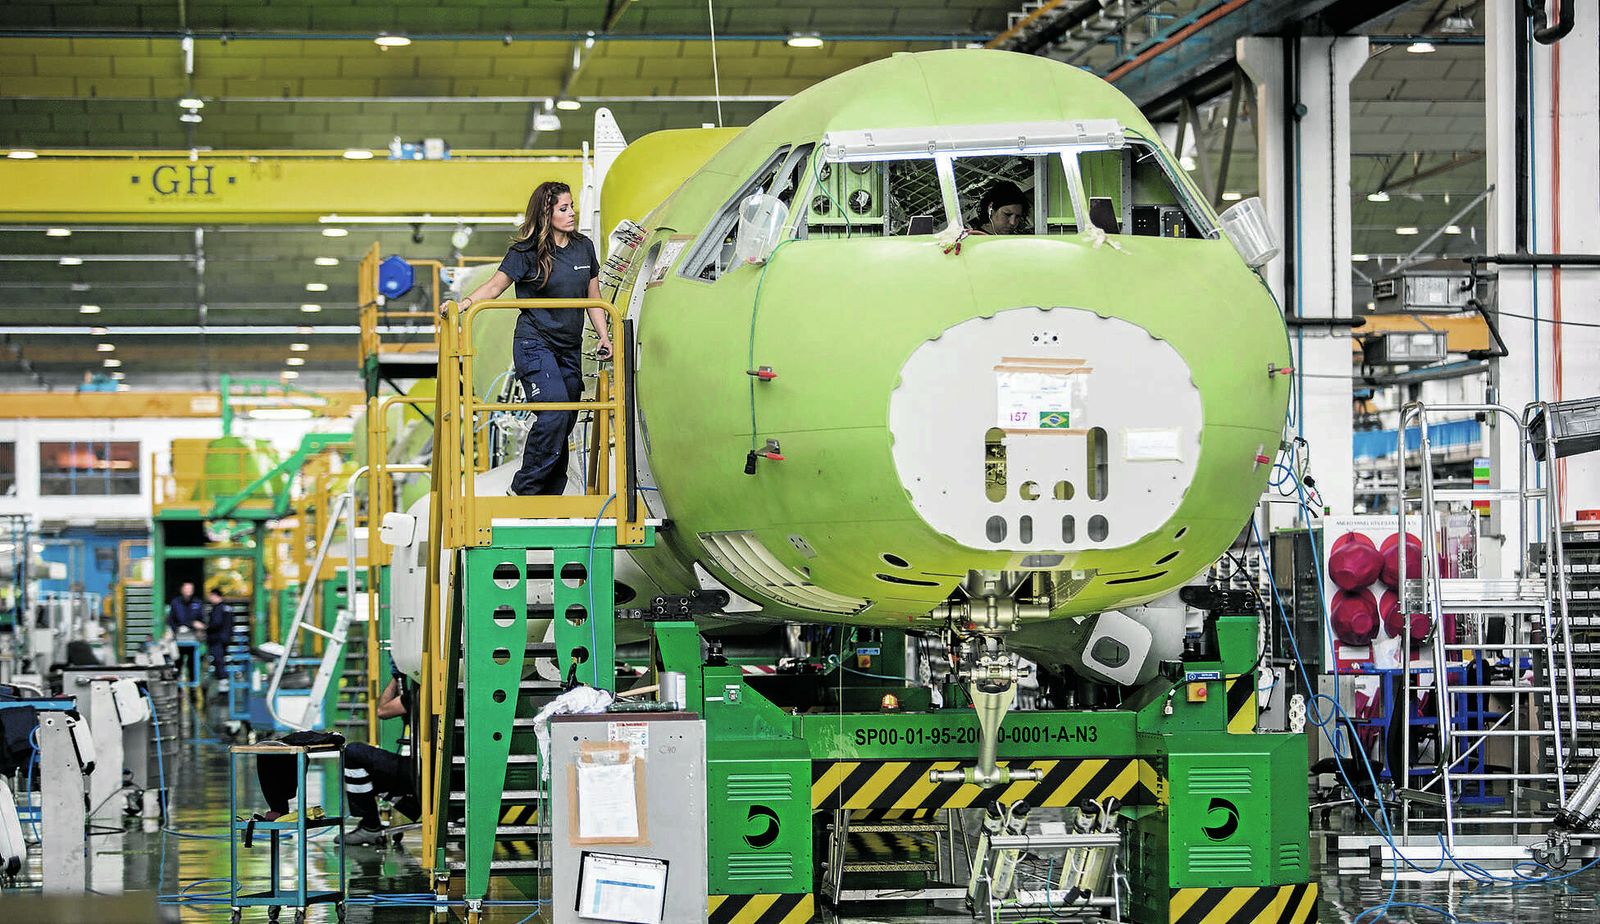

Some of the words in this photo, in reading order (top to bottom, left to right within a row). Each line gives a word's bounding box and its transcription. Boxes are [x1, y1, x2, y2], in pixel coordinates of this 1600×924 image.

[152, 165, 215, 195] GH
[1009, 411, 1028, 422] 157
[855, 726, 1098, 745] SP00-01-95-200-0001-A-N3
